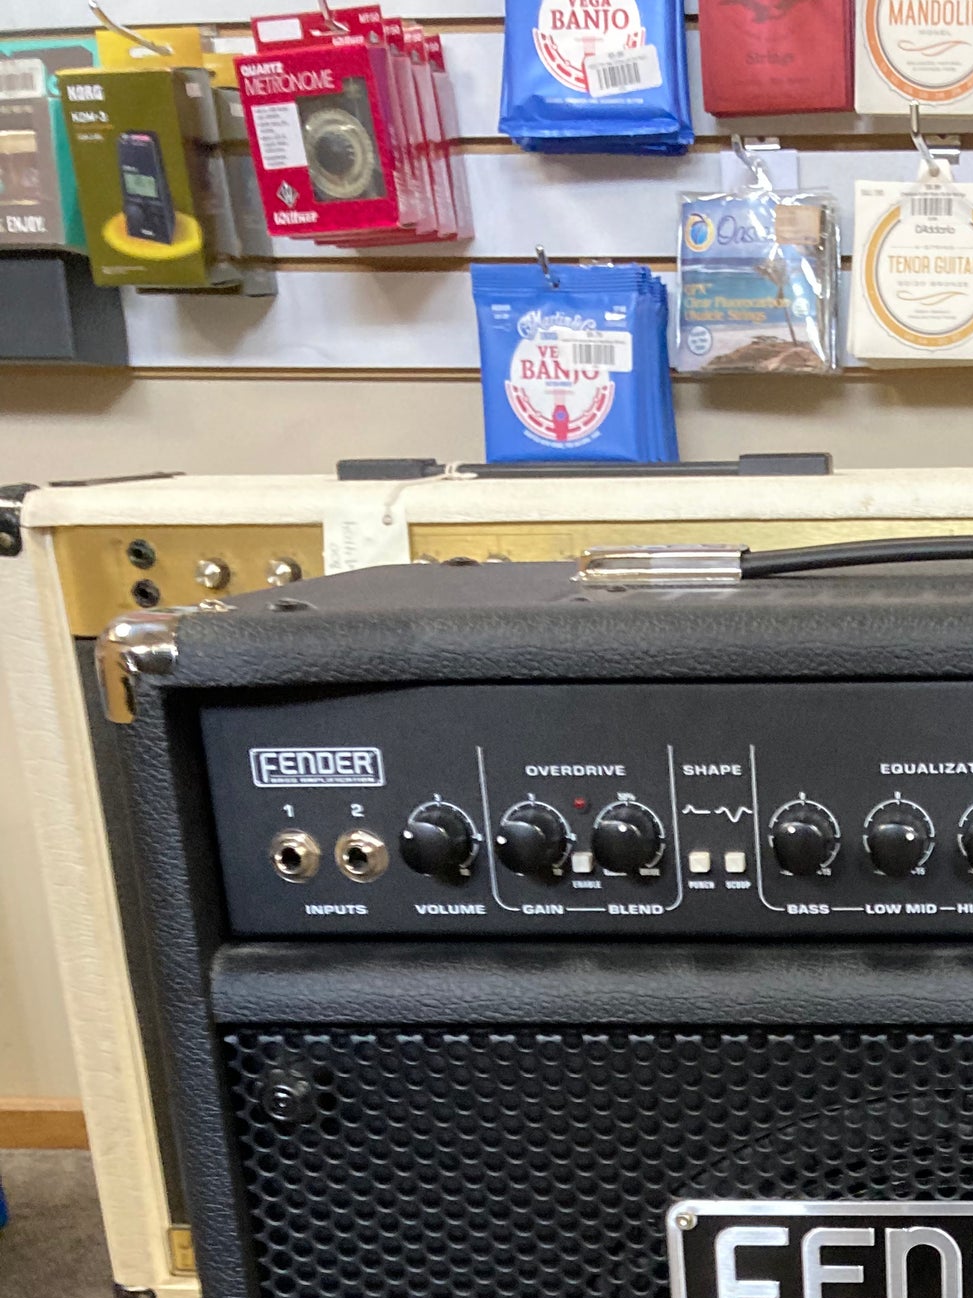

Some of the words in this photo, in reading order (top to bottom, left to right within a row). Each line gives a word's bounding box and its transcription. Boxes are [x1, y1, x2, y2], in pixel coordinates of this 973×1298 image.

[551, 9, 629, 34] BANJO
[745, 52, 795, 66] Strings
[240, 61, 284, 76] QUARTZ
[243, 69, 335, 96] METRONOME
[66, 84, 105, 101] KORG
[888, 255, 931, 274] TENOR
[727, 310, 767, 324] Strings
[536, 345, 559, 359] VE
[259, 751, 375, 784] FENDER
[524, 765, 627, 776] OVERDRIVE
[682, 764, 743, 776] SHAPE
[282, 804, 295, 818] 1
[350, 803, 365, 818] 2
[305, 904, 369, 915] INPUTS
[414, 904, 488, 915] VOLUME
[522, 904, 564, 915] GAIN
[608, 904, 665, 915] BLEND
[786, 903, 830, 915] BASS
[865, 904, 902, 914] LOW
[905, 903, 938, 914] MID
